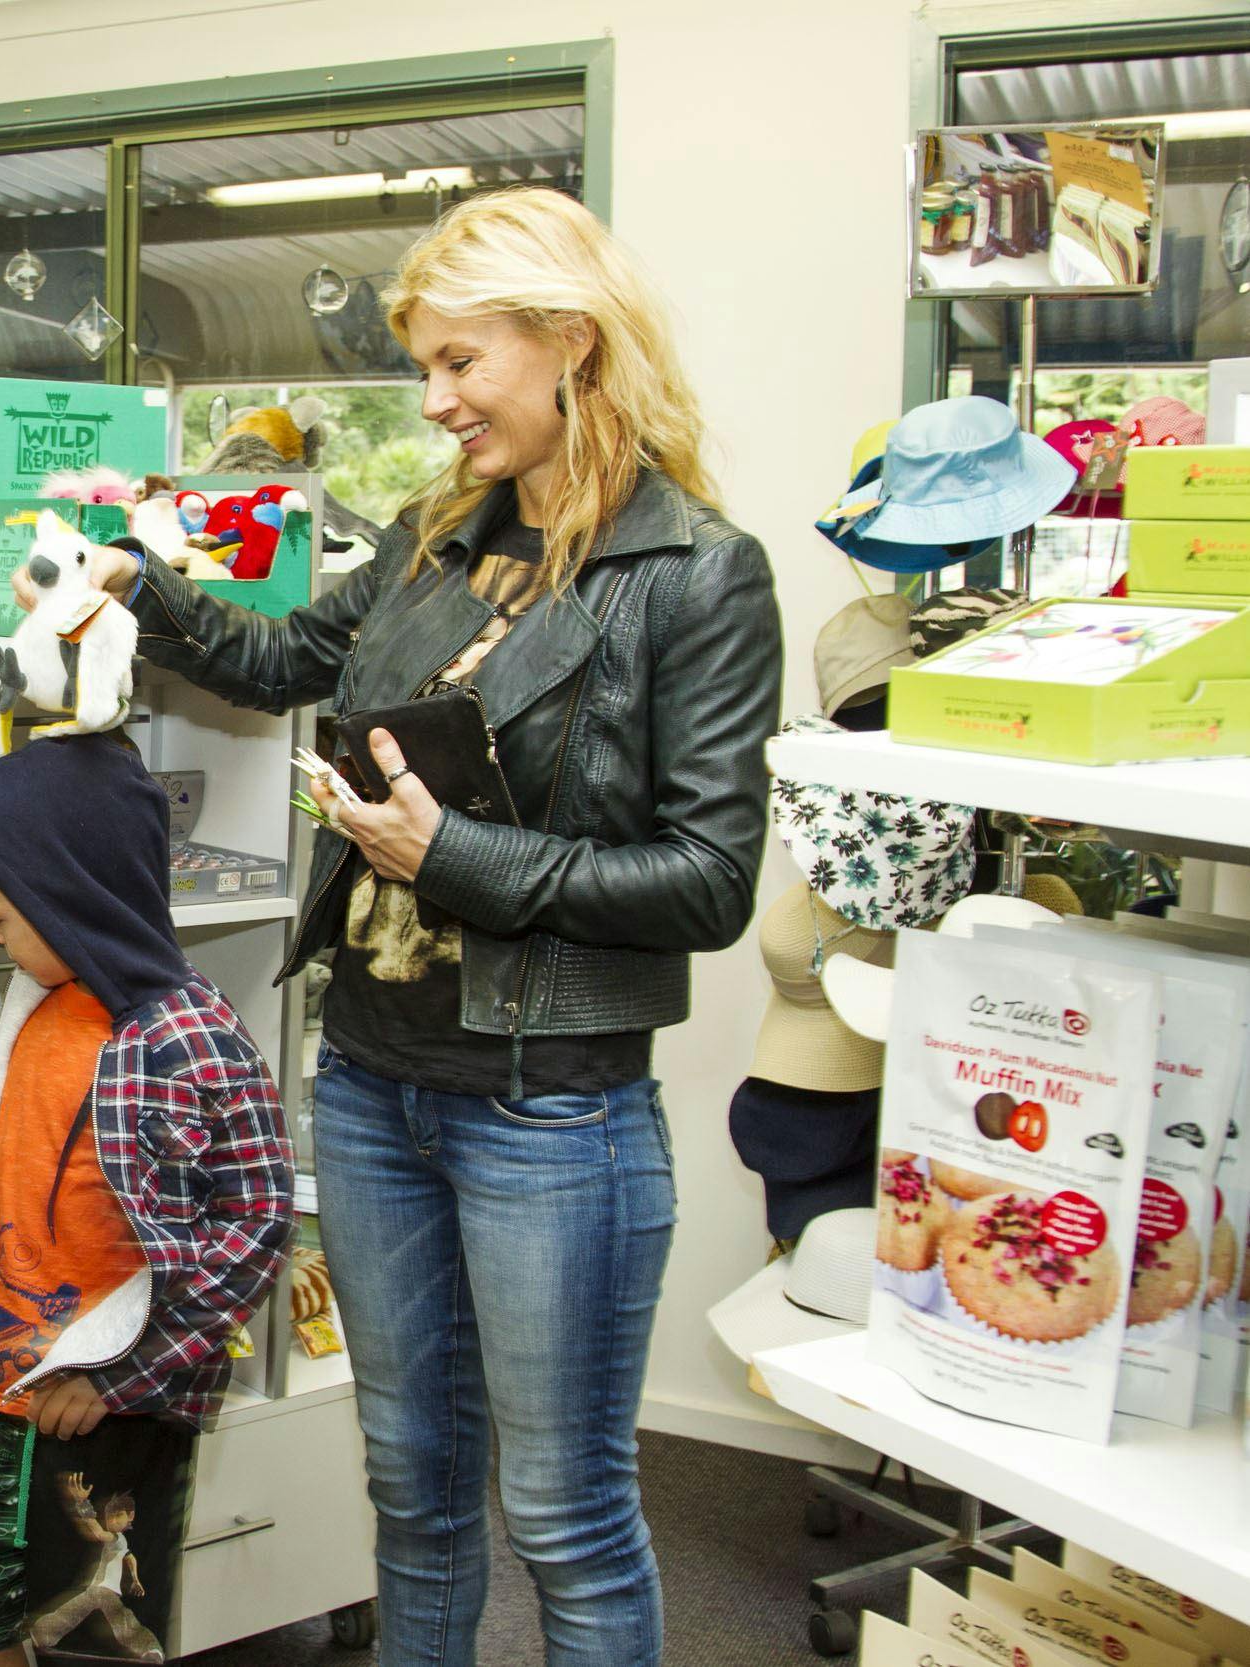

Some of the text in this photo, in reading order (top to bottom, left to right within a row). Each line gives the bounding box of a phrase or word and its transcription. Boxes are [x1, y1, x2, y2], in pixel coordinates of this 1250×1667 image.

[22, 425, 95, 448] WILD
[10, 481, 32, 491] SPARK
[969, 994, 1059, 1030] Oz Tukka
[923, 1035, 1119, 1088] Davidson Plum Macadamia Nut
[955, 1059, 1086, 1108] Muffin Mix
[950, 1612, 969, 1632] Oz
[1023, 1607, 1048, 1627] Oz
[918, 1654, 943, 1667] O
